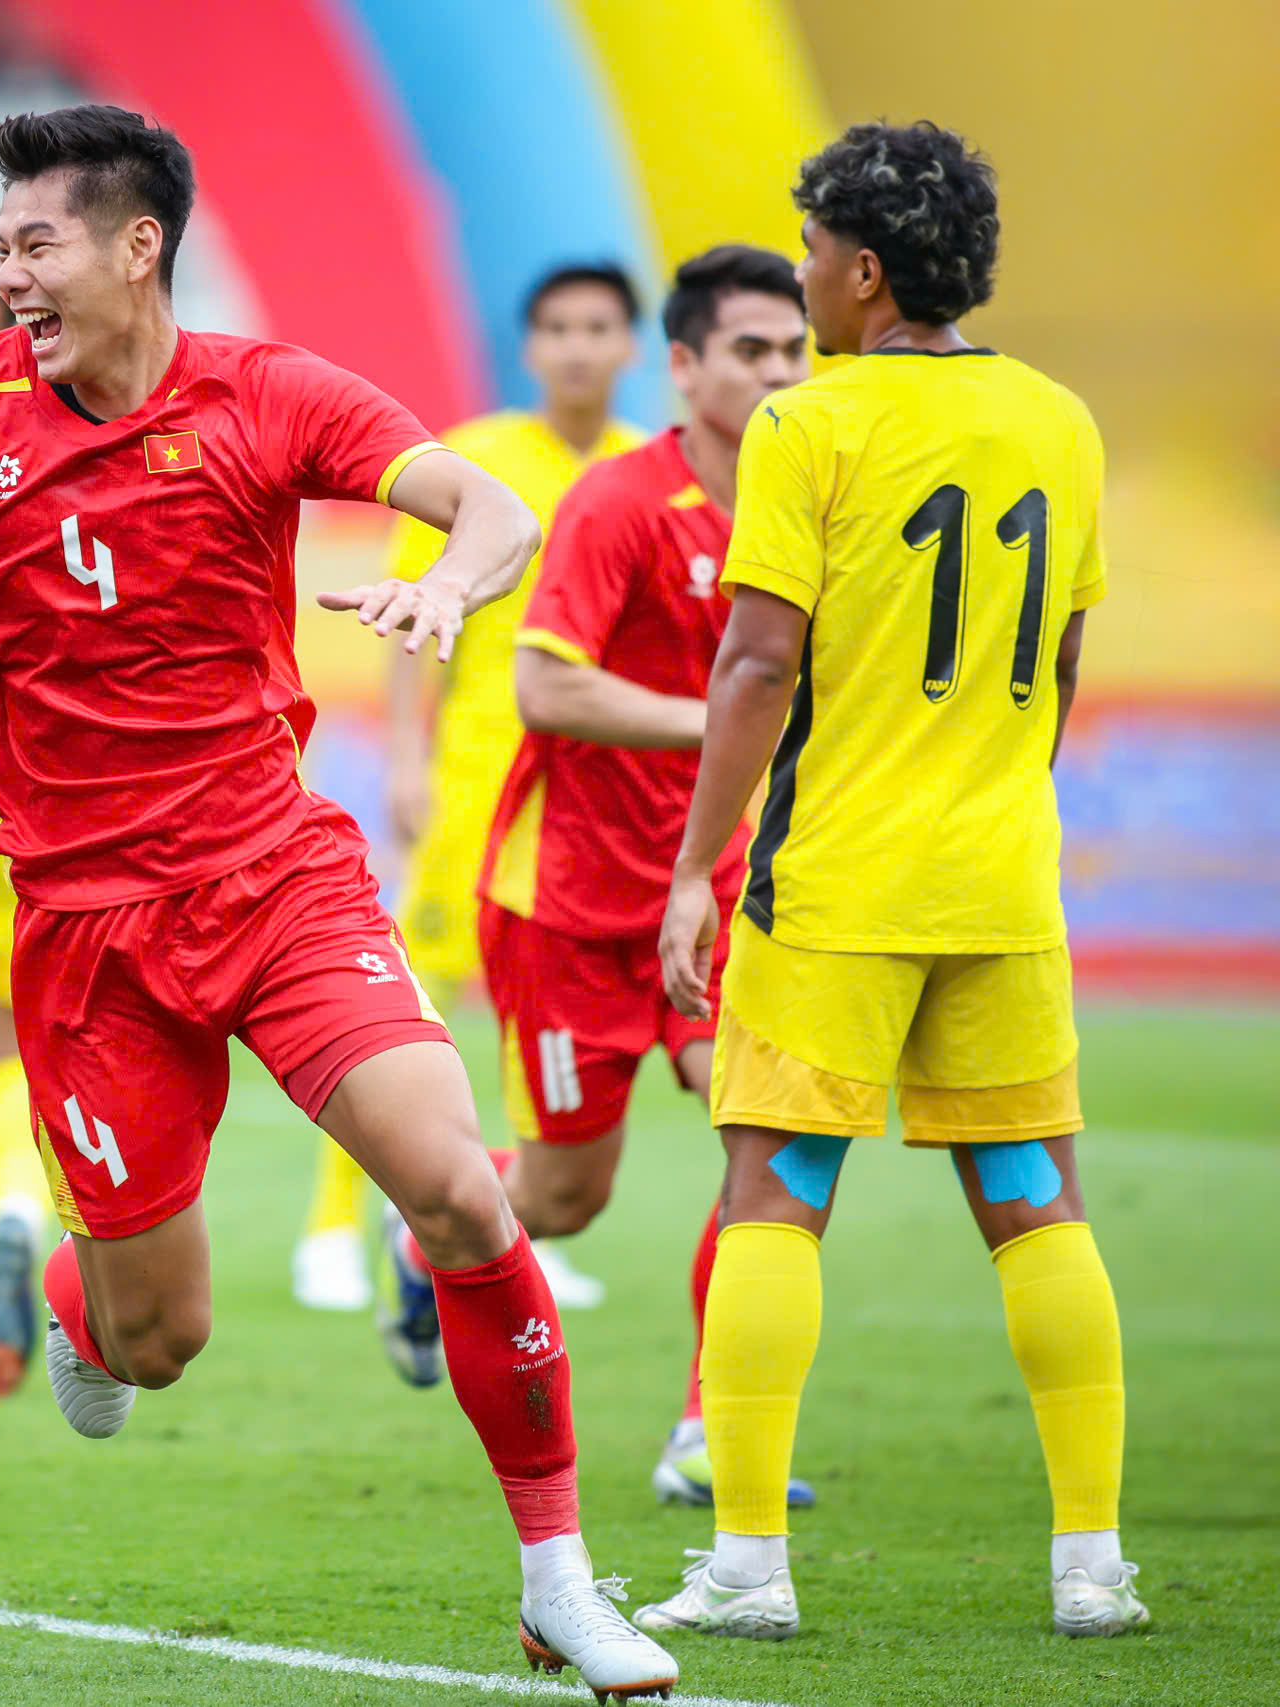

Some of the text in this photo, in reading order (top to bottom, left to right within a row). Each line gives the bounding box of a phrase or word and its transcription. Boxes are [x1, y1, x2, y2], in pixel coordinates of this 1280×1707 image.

[60, 513, 118, 611] 4
[901, 483, 1052, 711] 11
[924, 679, 950, 692] FAM
[1011, 681, 1031, 696] FAM
[63, 1093, 129, 1189] 4
